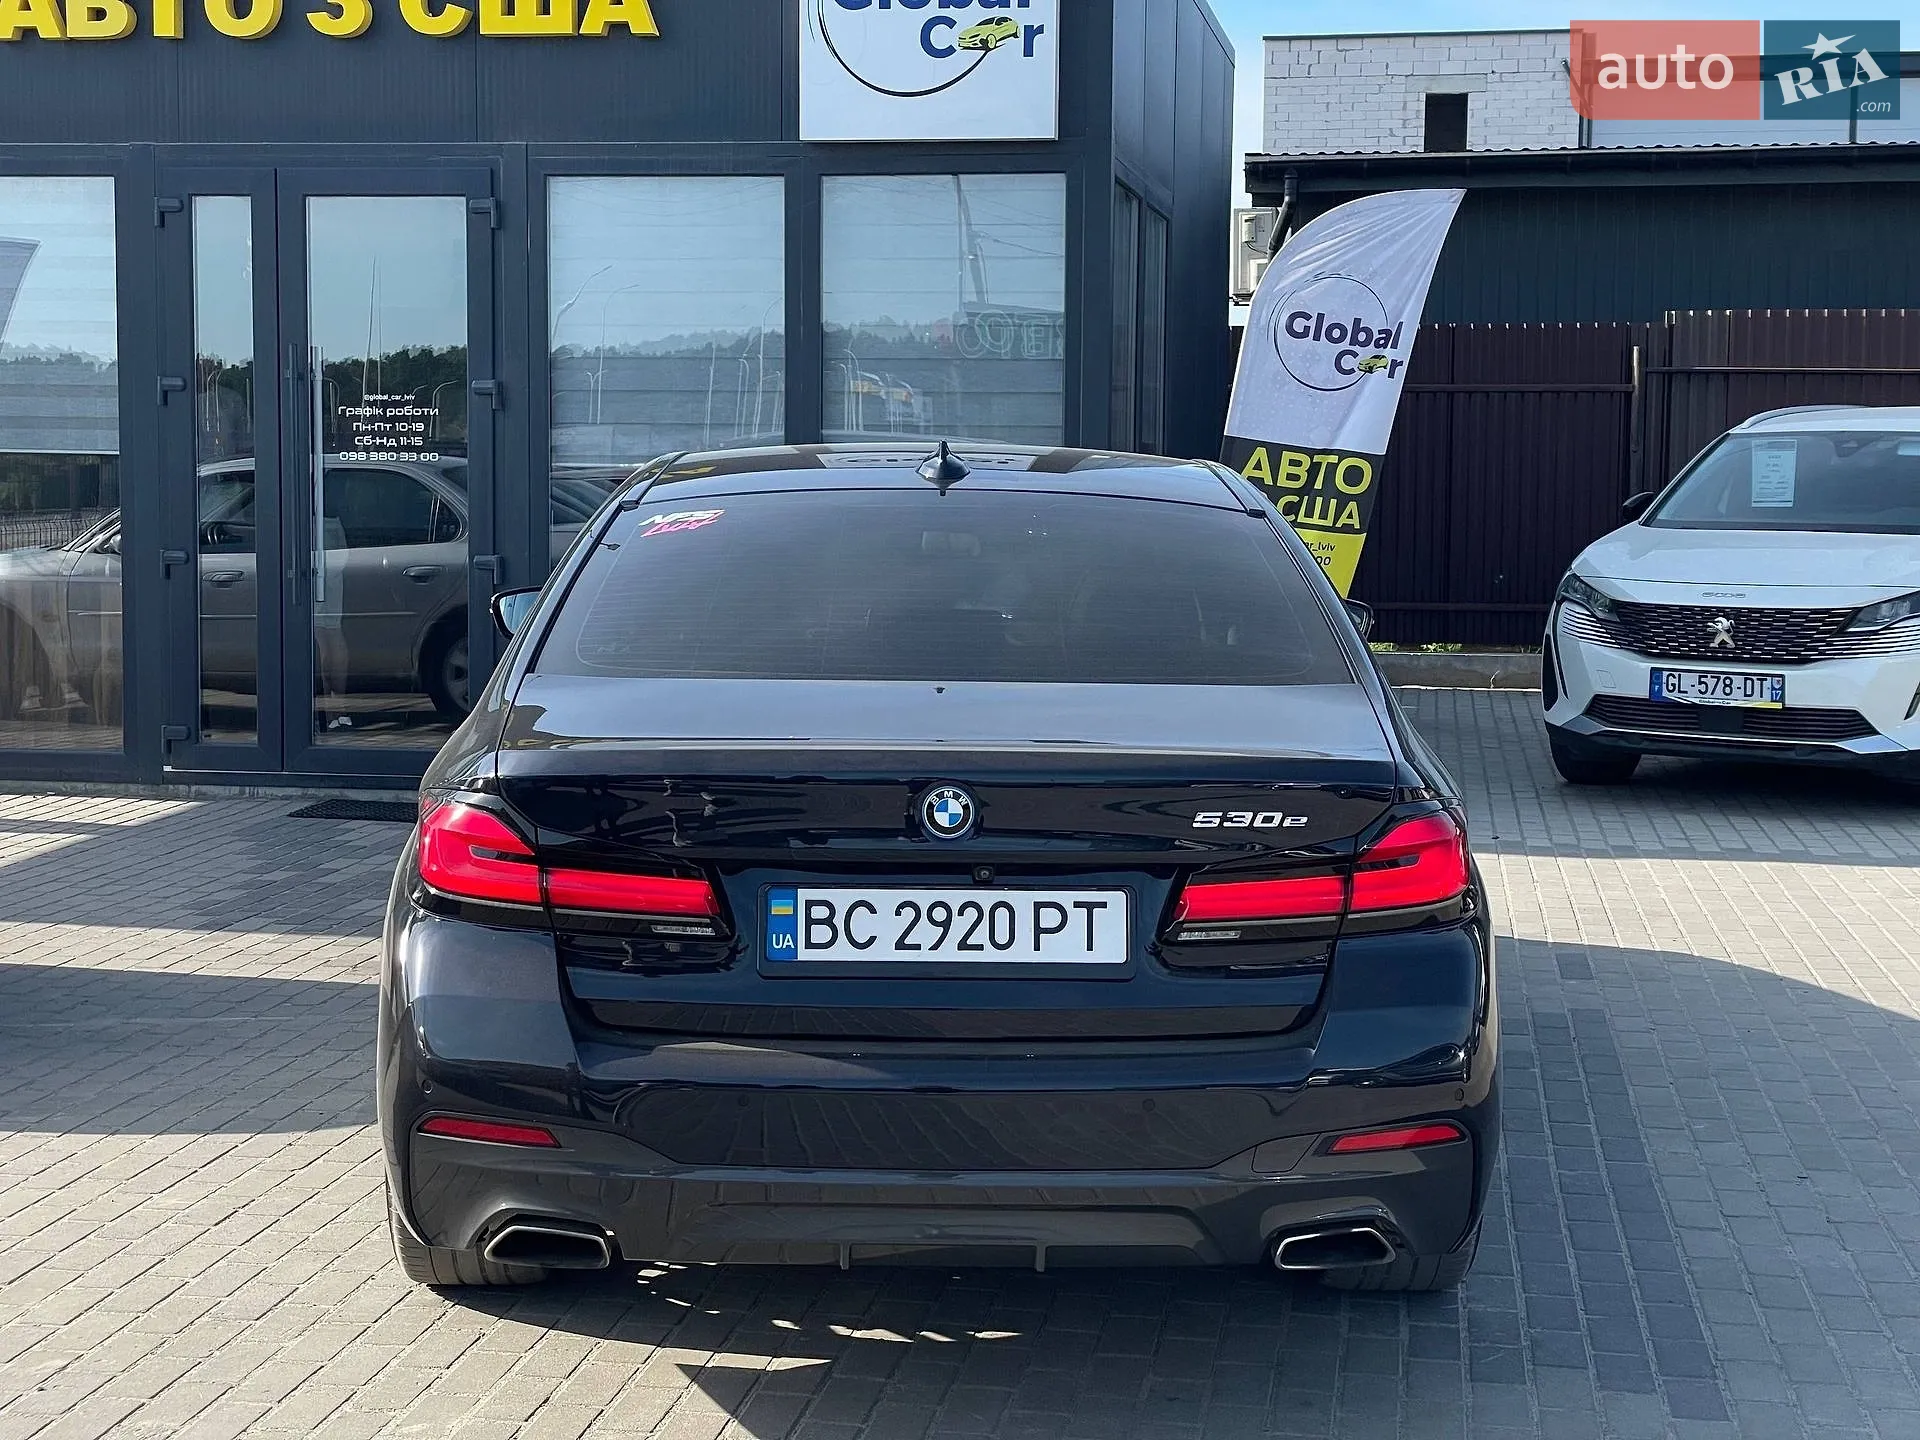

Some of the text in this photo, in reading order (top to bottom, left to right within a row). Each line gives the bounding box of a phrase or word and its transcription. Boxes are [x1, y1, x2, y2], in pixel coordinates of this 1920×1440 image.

[920, 15, 1044, 58] Cr
[1285, 311, 1404, 350] Global
[1334, 349, 1404, 379] Cr
[338, 404, 439, 417] Графік роботи
[353, 422, 425, 432] Пн-Пт 10-19
[354, 435, 423, 447] Сб-Нд 11-15
[340, 452, 439, 461] 098 380 33 00
[1239, 446, 1373, 495] АВТО
[1275, 494, 1361, 530] США
[1665, 672, 1768, 699] GL-578-DT
[1772, 690, 1782, 700] 17
[930, 790, 968, 806] BMW
[1192, 811, 1308, 828] 530e
[804, 900, 1108, 952] BC 2920 PT
[772, 934, 795, 949] UA
